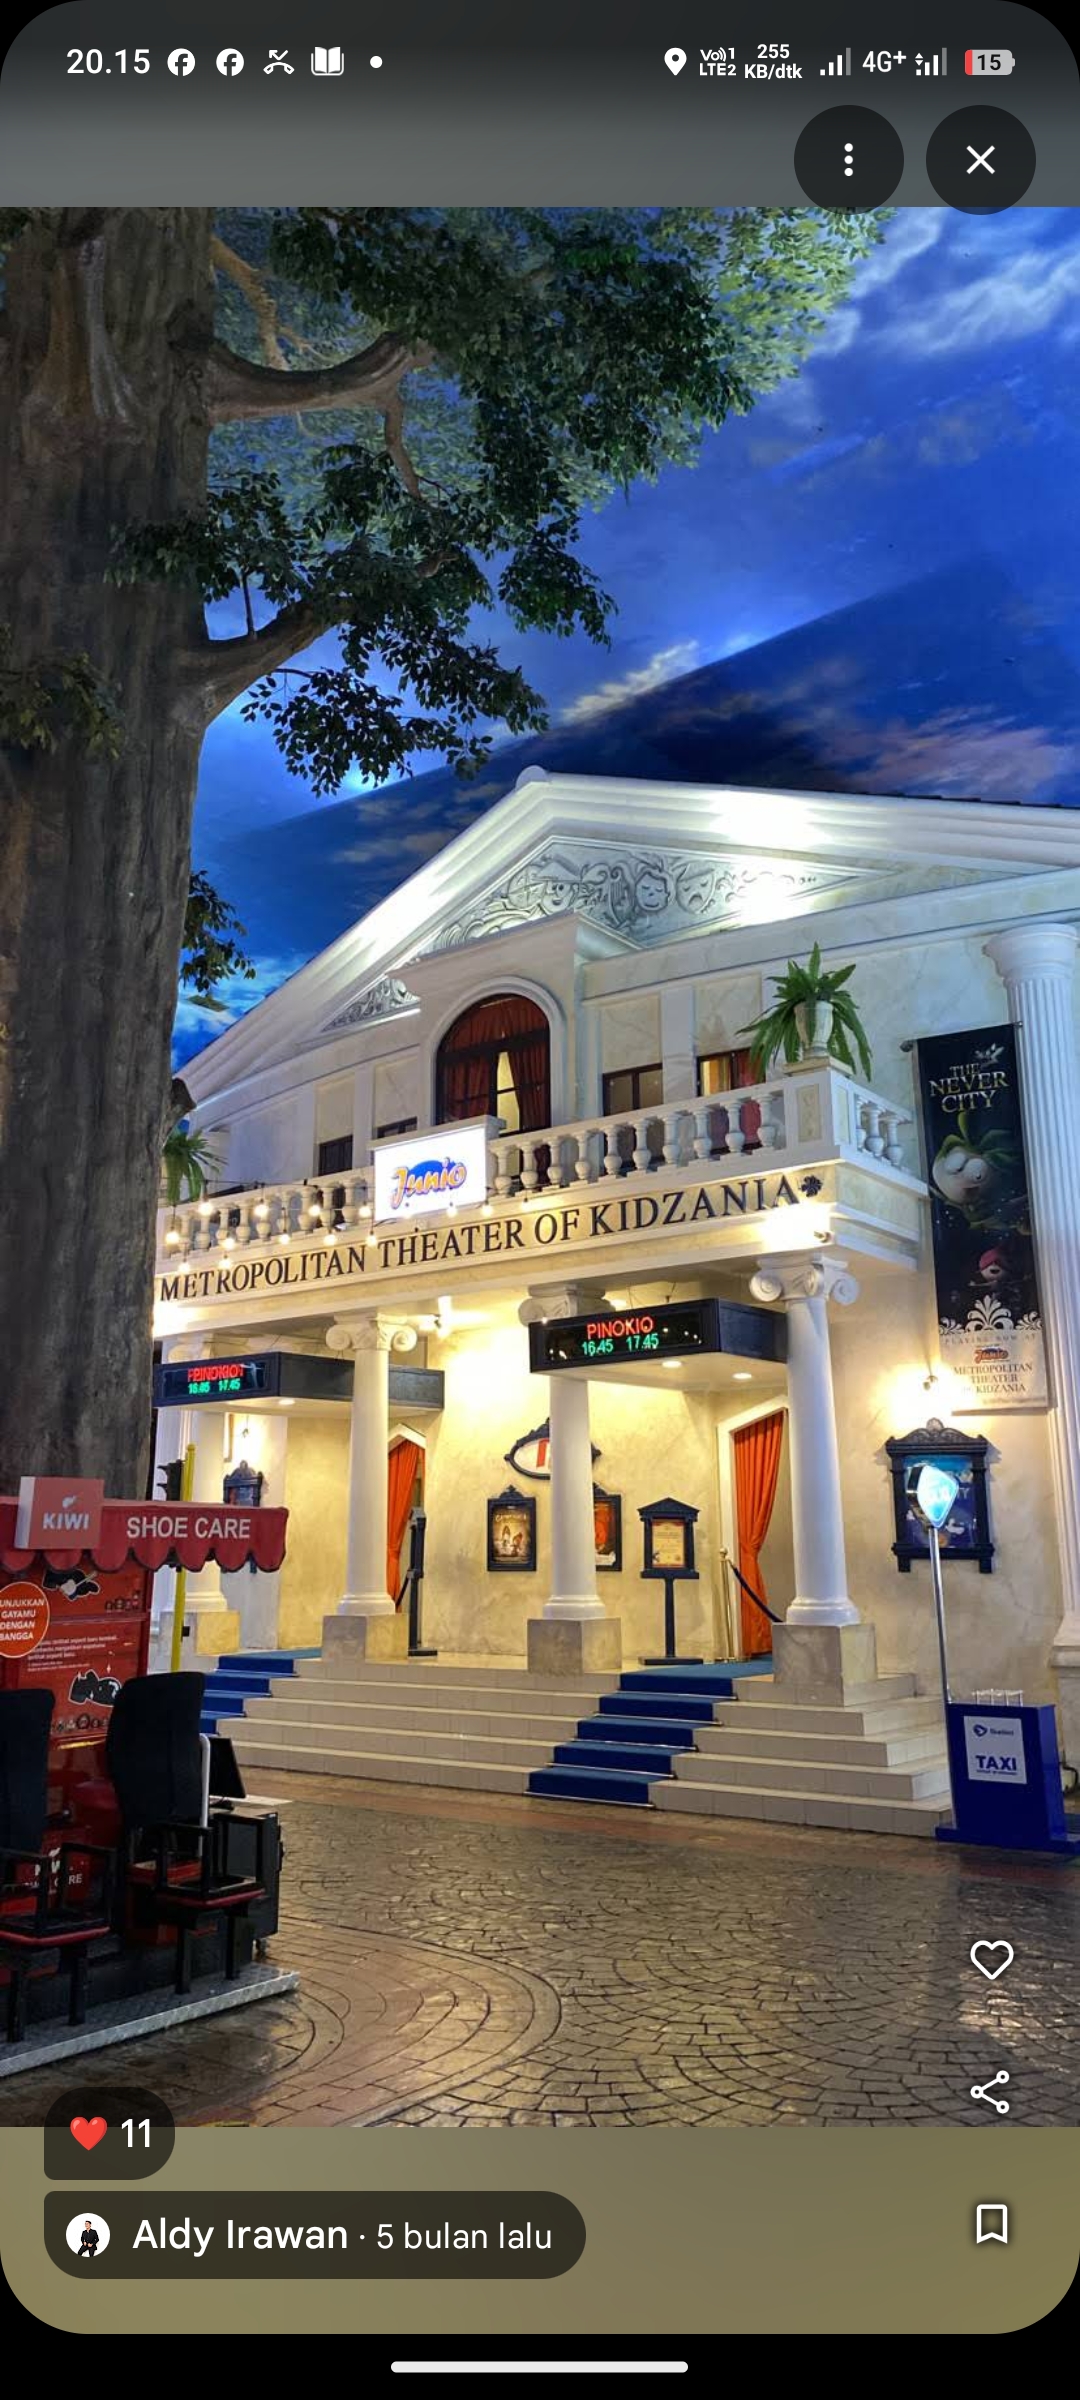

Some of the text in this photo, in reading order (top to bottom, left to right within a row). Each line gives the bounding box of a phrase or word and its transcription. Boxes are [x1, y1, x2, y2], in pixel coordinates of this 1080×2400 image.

[949, 1063, 979, 1077] THE
[929, 1071, 1009, 1096] NEVER
[941, 1090, 997, 1112] CITY
[390, 1157, 468, 1209] Junio
[160, 1173, 800, 1301] METROPOLITAN THEATER OF KIDZANIA
[586, 1316, 654, 1340] PINOKIO
[582, 1333, 660, 1356] 16.45 17.45
[954, 1362, 1033, 1376] METROPOLITAN
[971, 1372, 1018, 1384] THEATER
[976, 1382, 1027, 1394] KIDZANIA
[42, 1512, 90, 1530] KIWI
[126, 1516, 251, 1539] SHOE CARE
[0, 1599, 45, 1608] UNJUKKAN
[1, 1609, 36, 1619] GAYAMU
[975, 1754, 1017, 1771] TAXI
